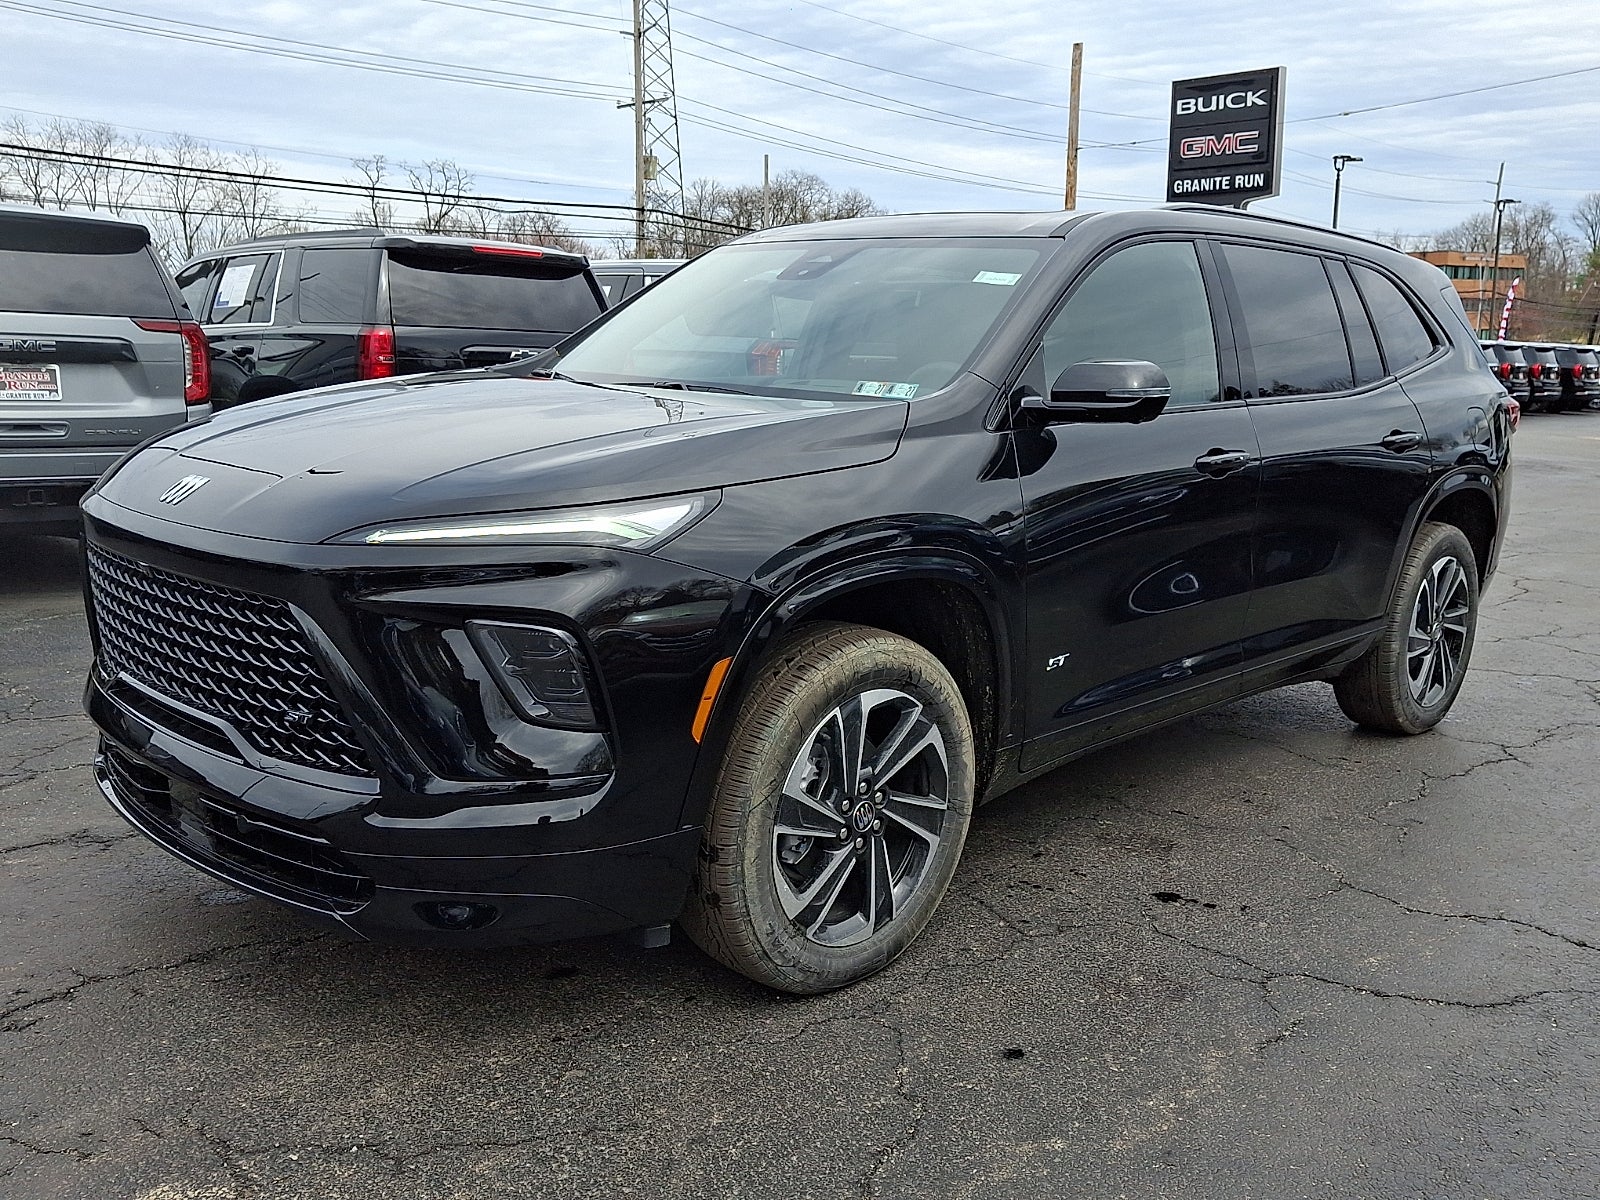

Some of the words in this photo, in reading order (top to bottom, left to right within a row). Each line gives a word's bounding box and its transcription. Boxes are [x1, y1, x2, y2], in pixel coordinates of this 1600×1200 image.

[1176, 89, 1268, 115] BUICK
[1180, 131, 1259, 159] GMC
[1173, 176, 1231, 193] GRANITE
[1234, 173, 1264, 189] RUN
[0, 339, 57, 352] GMC
